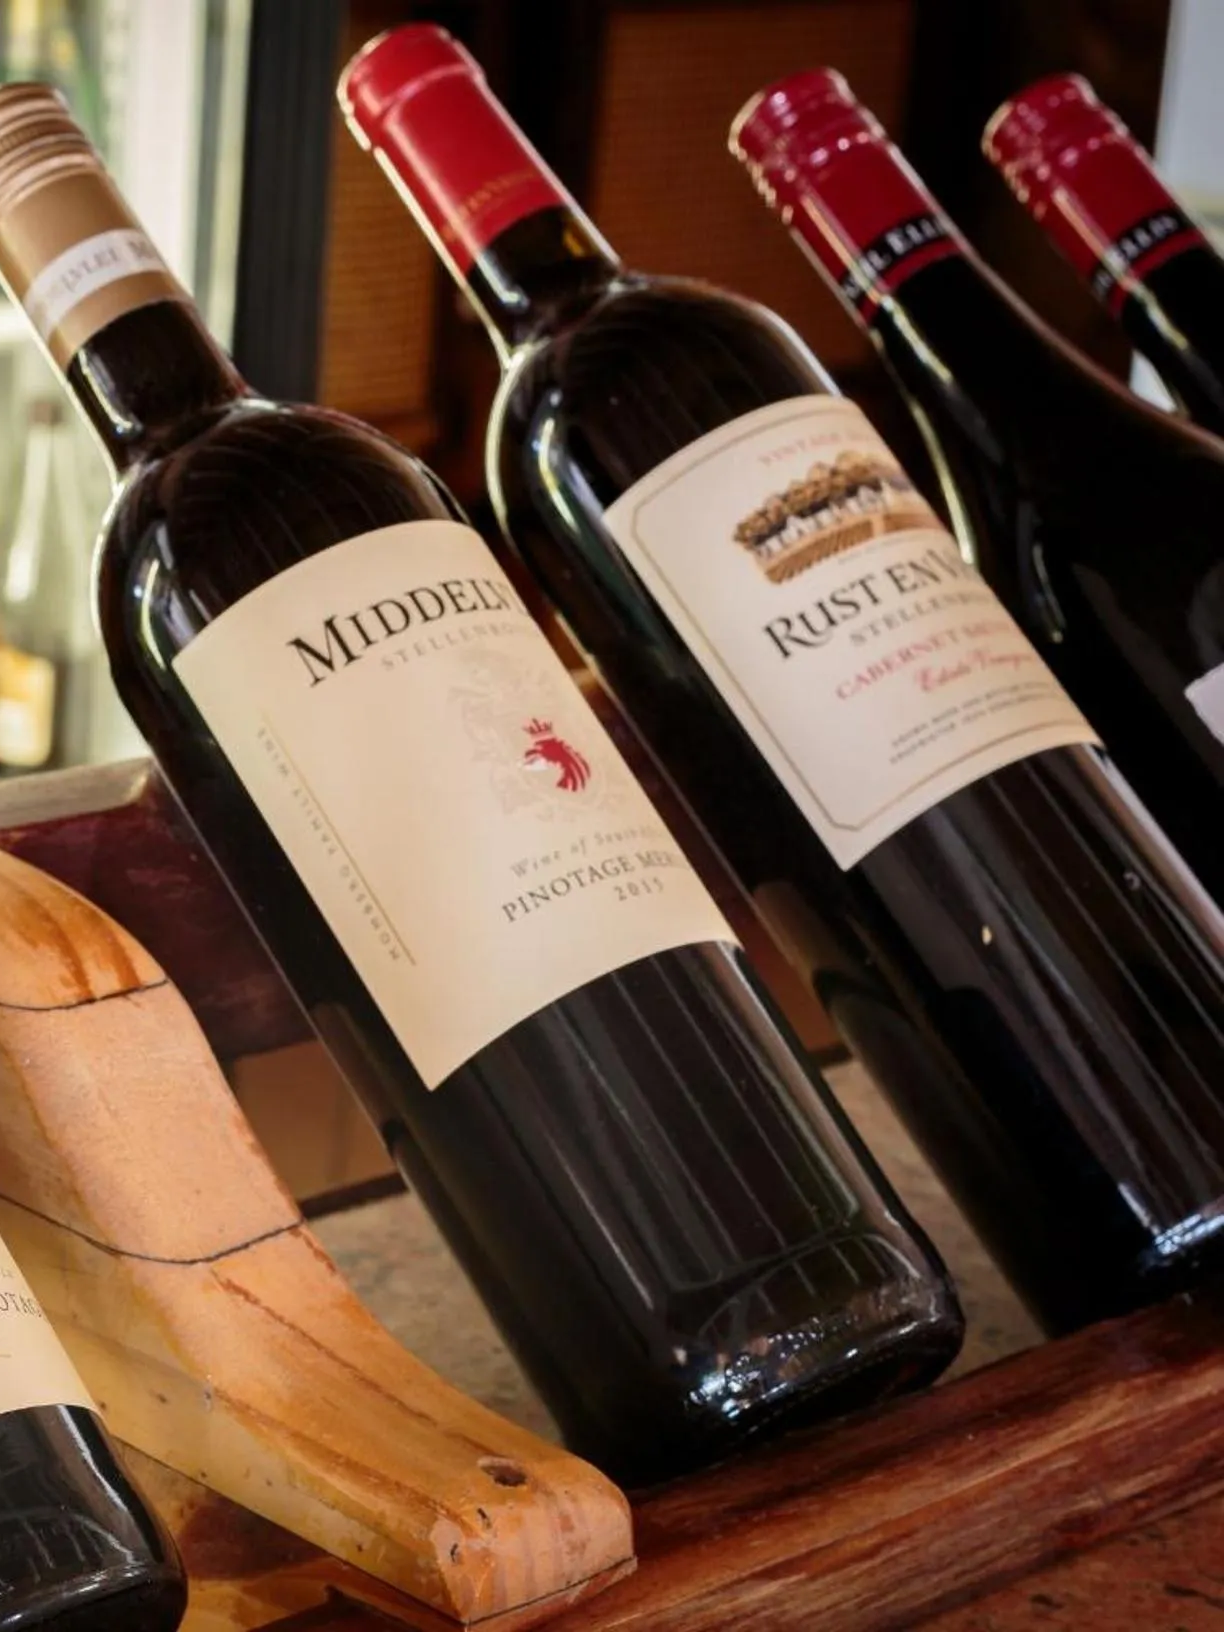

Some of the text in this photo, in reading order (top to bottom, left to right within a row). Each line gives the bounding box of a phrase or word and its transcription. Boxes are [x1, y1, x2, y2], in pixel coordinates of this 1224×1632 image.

[285, 578, 514, 688] MIDDELV
[763, 573, 883, 660] RUST
[501, 855, 636, 924] PINOTAGE
[613, 876, 664, 902] 2015
